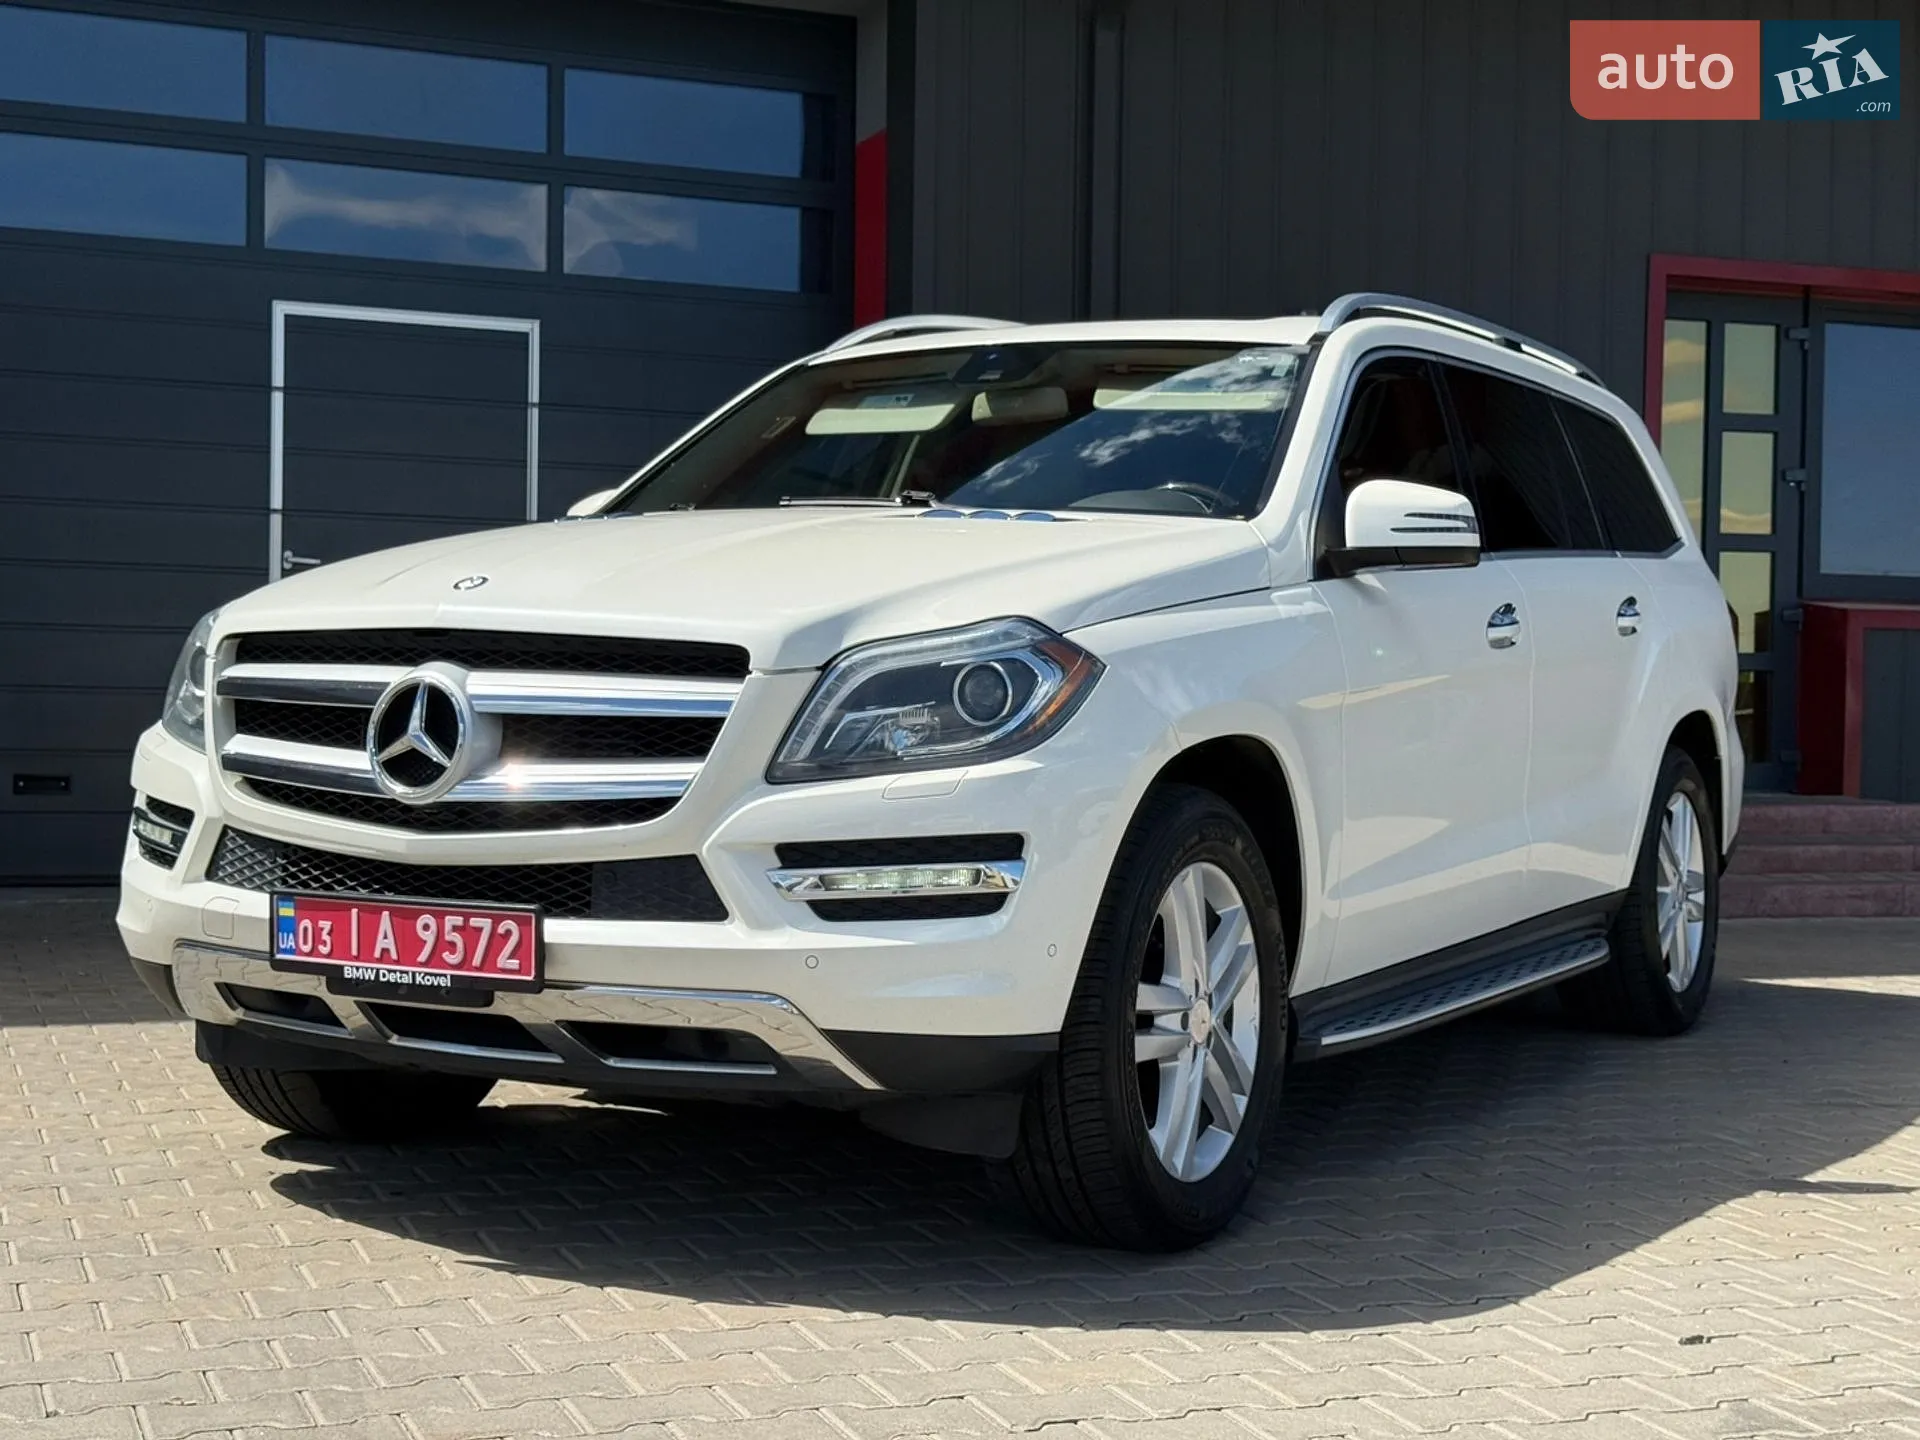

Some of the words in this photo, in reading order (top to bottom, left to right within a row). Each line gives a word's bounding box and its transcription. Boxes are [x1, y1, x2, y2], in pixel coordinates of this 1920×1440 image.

[279, 932, 295, 949] UA
[298, 919, 333, 956] 03
[416, 914, 521, 970] 9572
[344, 966, 376, 981] BMW
[378, 969, 413, 984] Detal
[415, 972, 451, 987] Kovel
